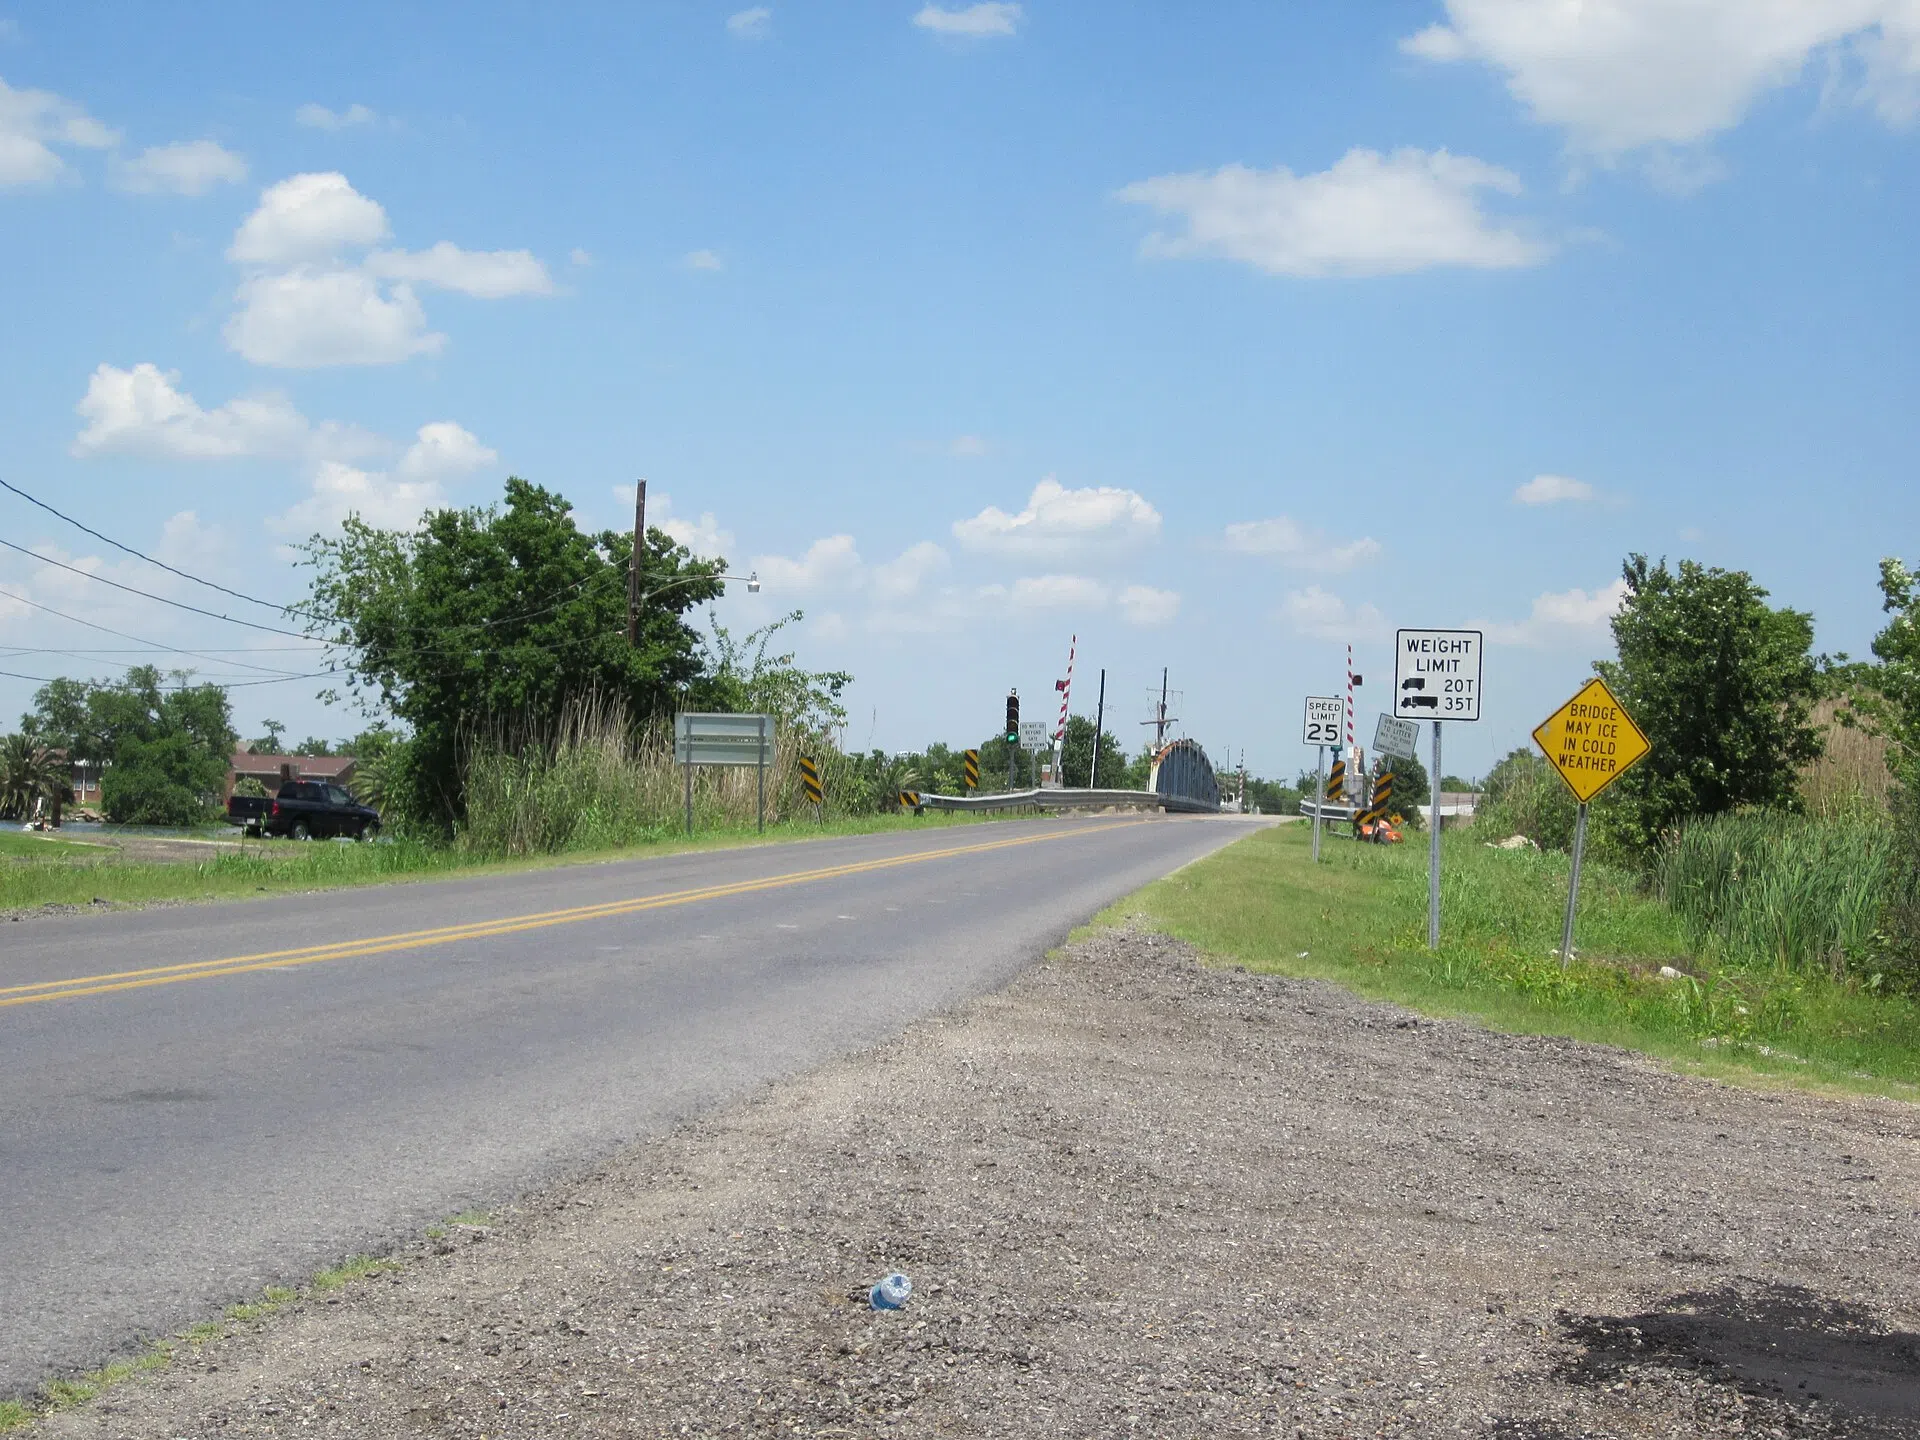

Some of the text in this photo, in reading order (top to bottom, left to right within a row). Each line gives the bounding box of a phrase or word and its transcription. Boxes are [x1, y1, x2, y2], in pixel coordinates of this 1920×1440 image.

[1407, 639, 1472, 653] WEIGHT
[1416, 658, 1460, 672] LIMIT
[1444, 679, 1474, 692] 20T
[1309, 702, 1340, 711] SPEED
[1445, 697, 1473, 711] 35T
[1311, 712, 1336, 720] LIMIT
[1570, 703, 1617, 721] BRIDGE
[1307, 723, 1338, 741] 25
[1565, 720, 1618, 738] MAY ICE
[1563, 737, 1616, 755] IN COLD
[1559, 753, 1617, 772] WEATHER
